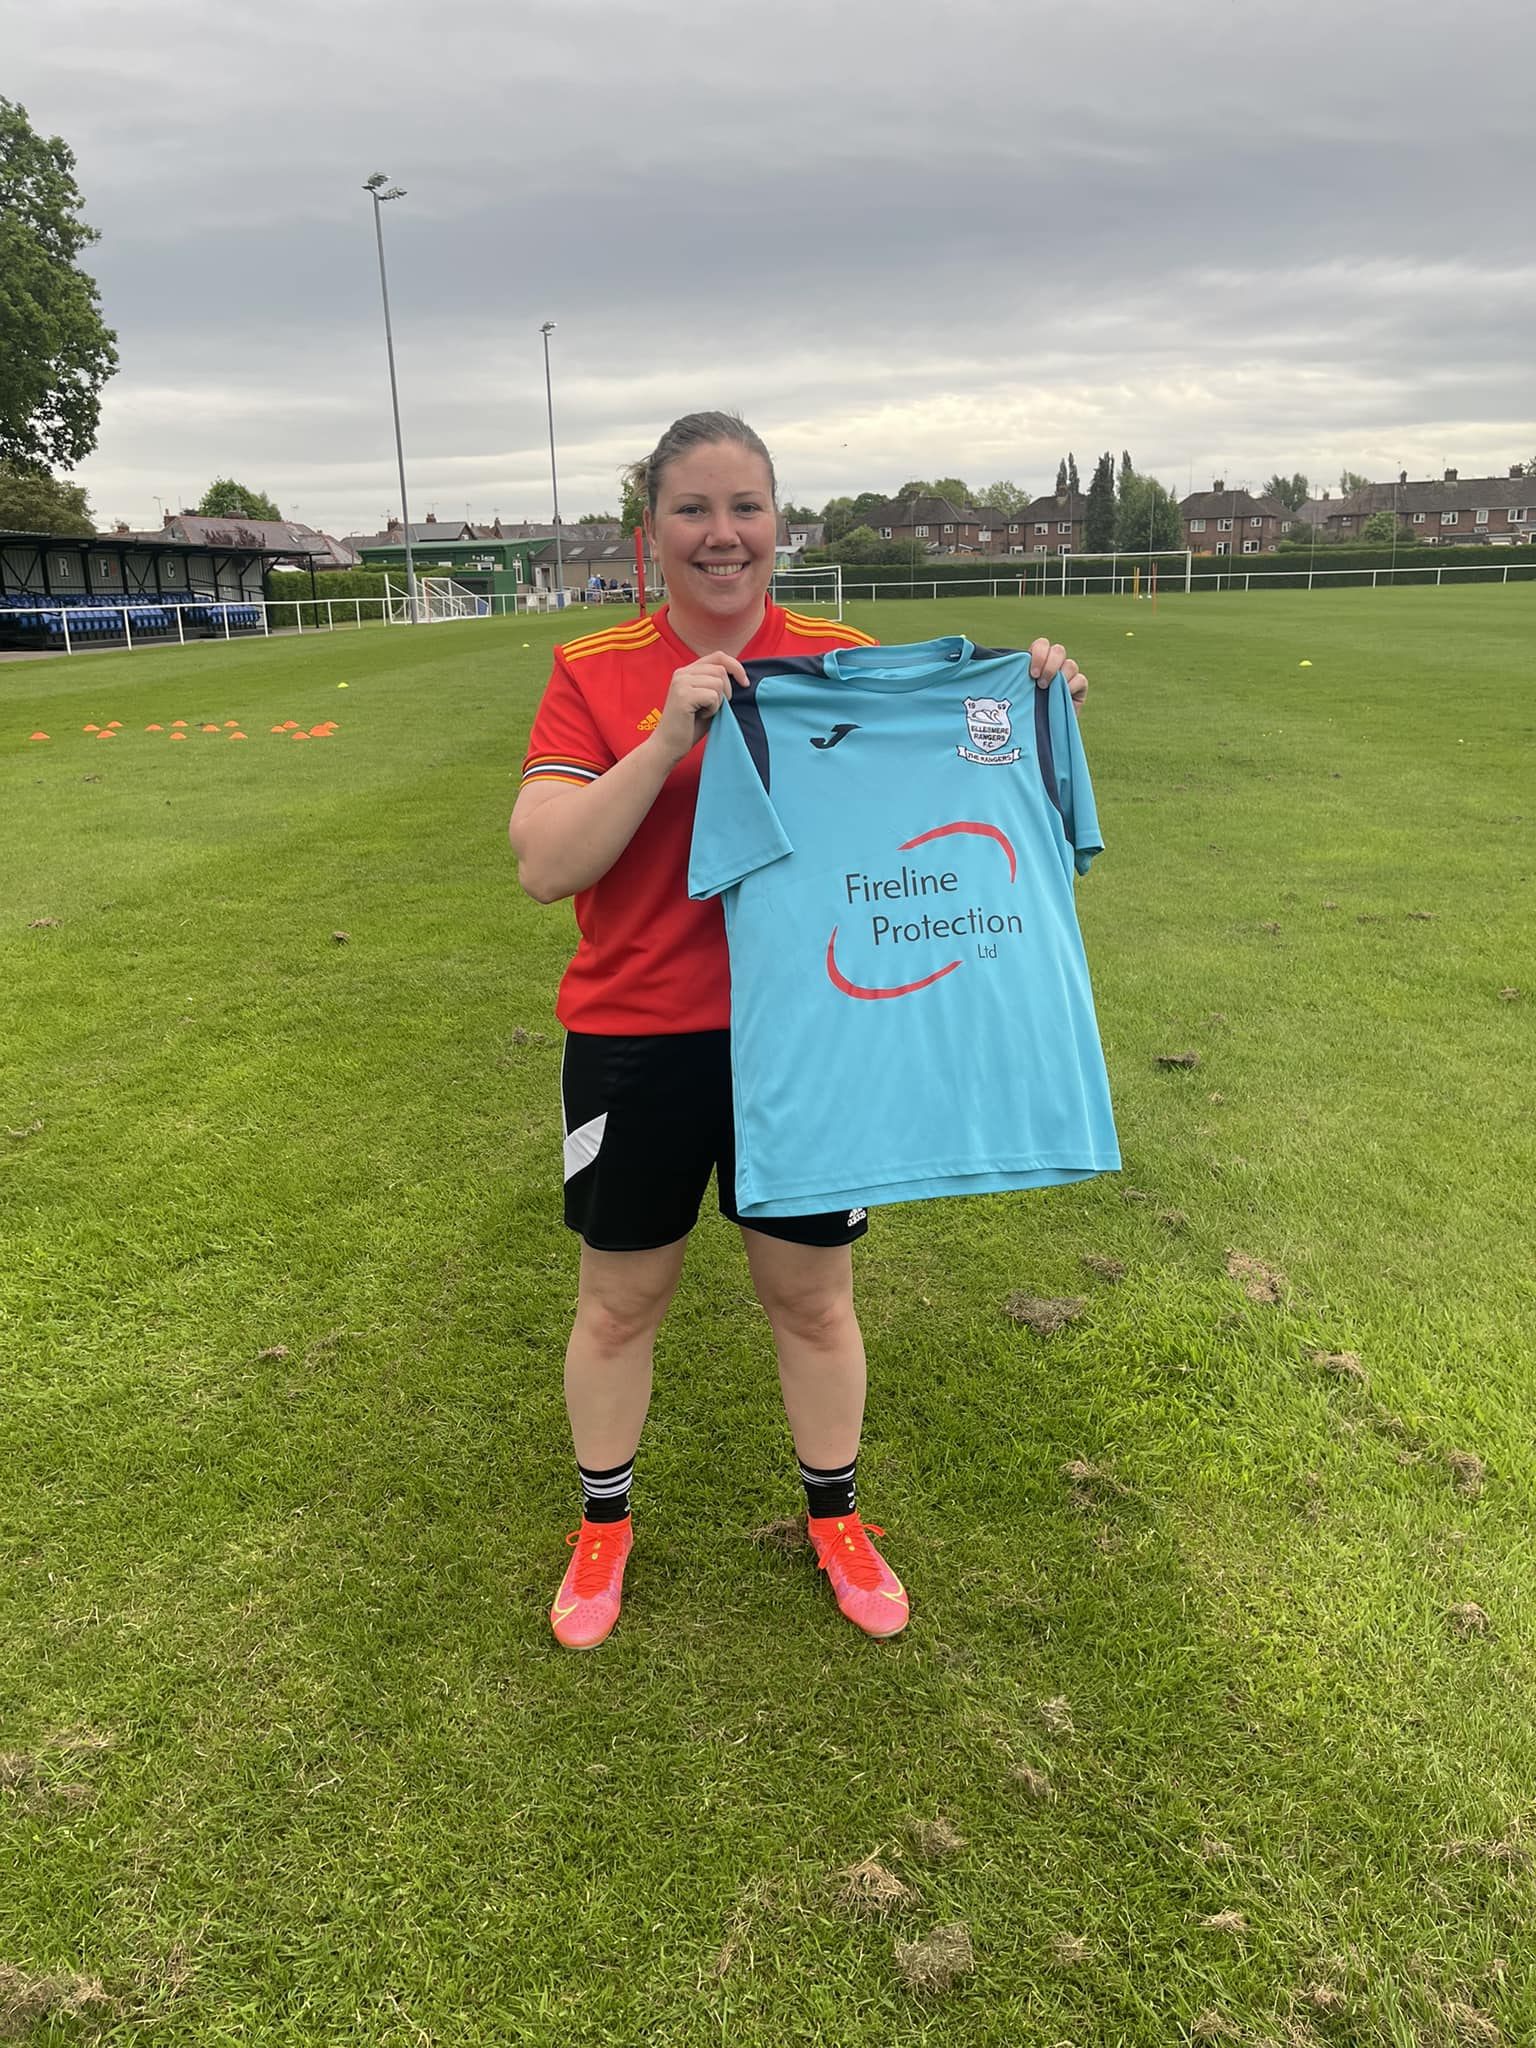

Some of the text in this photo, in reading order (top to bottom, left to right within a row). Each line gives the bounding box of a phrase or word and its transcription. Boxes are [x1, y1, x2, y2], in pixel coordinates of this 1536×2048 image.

[59, 558, 69, 577] R
[971, 726, 1009, 735] ELLESMERE
[973, 733, 1006, 742] RANGERS
[980, 754, 1012, 763] RANGERS
[845, 866, 958, 904] Fireline
[872, 907, 1023, 946] Protection
[977, 943, 998, 959] Ltd
